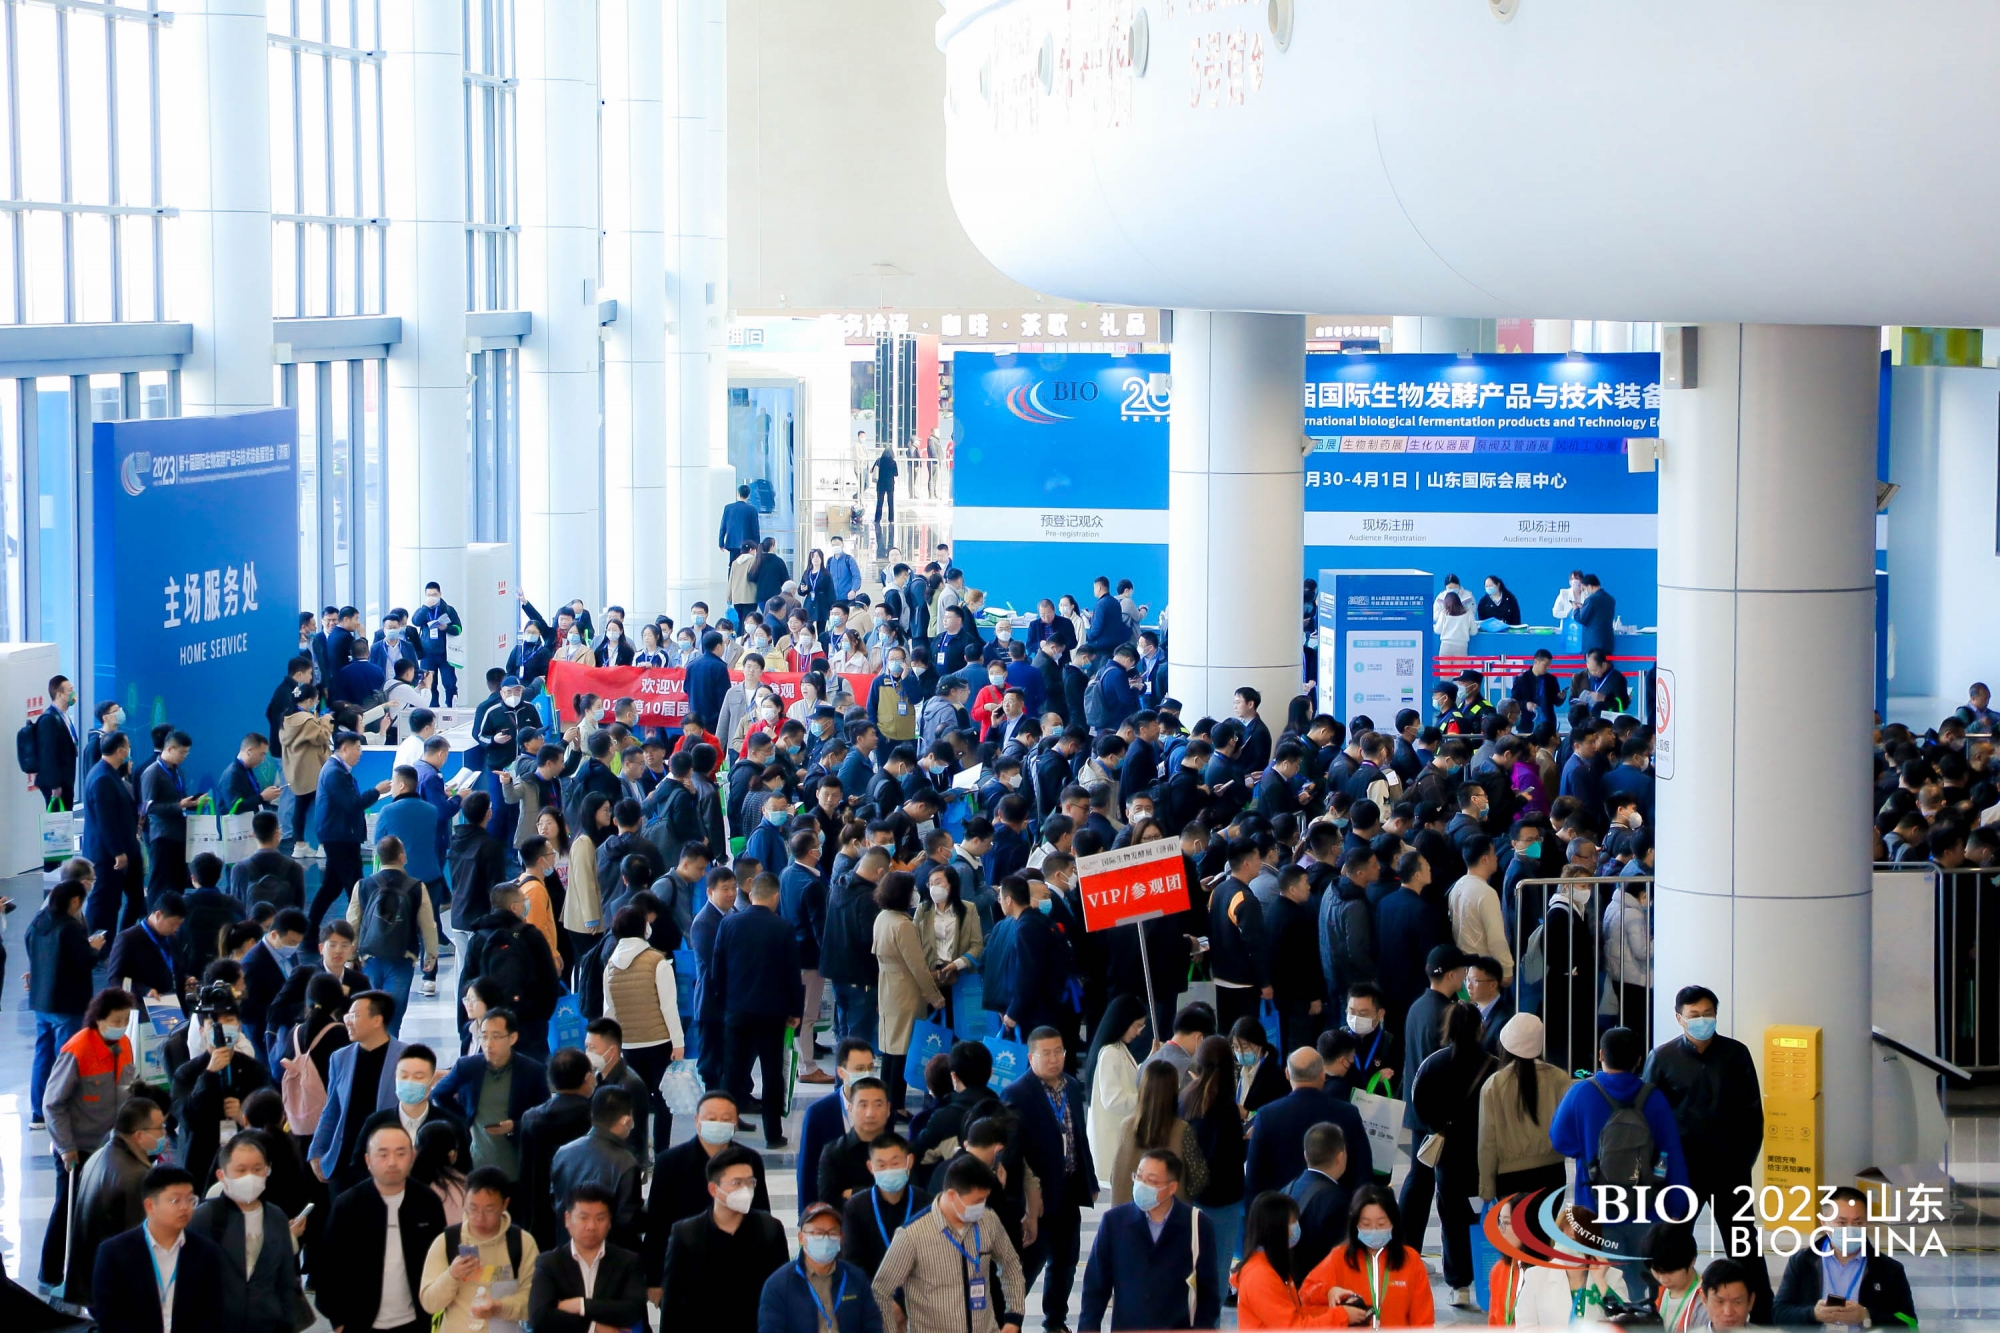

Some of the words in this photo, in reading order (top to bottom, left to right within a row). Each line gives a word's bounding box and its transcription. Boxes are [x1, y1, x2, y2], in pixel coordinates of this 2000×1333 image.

[1099, 313, 1146, 337] 礼品
[1053, 381, 1098, 401] BIO
[1360, 416, 1415, 429] biological
[1418, 416, 1495, 428] fermentation
[1499, 417, 1550, 430] products
[1553, 417, 1575, 428] and
[1578, 416, 1647, 430] Technology
[1343, 439, 1403, 451] 生物制药展
[1409, 439, 1471, 451] 生化仪器展
[1476, 439, 1550, 452] 泵阀及管道展
[152, 455, 176, 485] 2023
[1427, 472, 1568, 490] 山东国际会展中心
[1041, 515, 1104, 528] 预登记观众
[1362, 518, 1414, 532] 现场注册
[1518, 520, 1570, 534] 现场注册
[1045, 530, 1100, 539] Pre-registration
[1348, 534, 1382, 543] Audience
[1384, 534, 1427, 544] Registration
[1503, 535, 1536, 544] Audience
[1539, 536, 1583, 545] Registration
[164, 561, 258, 629] 主场服务处
[180, 641, 207, 666] HOME
[210, 633, 248, 658] SERVICE
[1087, 873, 1183, 909] VIP/参观团
